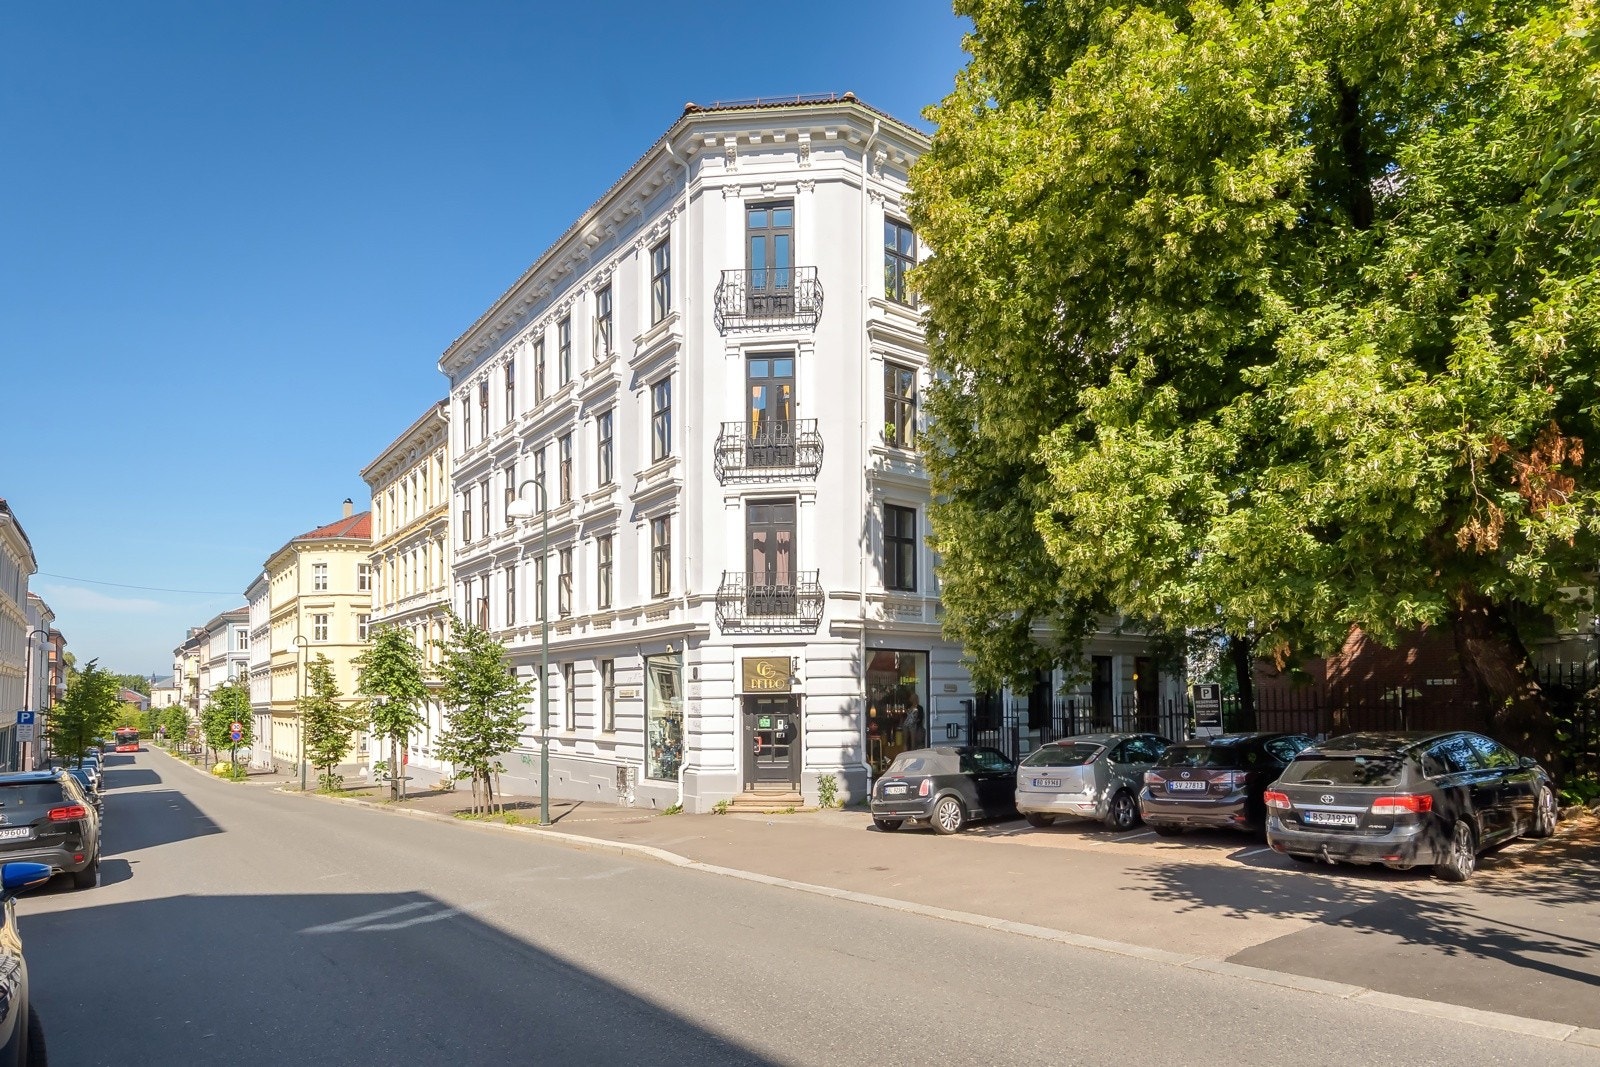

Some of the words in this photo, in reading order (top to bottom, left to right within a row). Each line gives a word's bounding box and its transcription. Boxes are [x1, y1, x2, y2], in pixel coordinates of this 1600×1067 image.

[751, 678, 785, 689] RETRO
[1203, 689, 1210, 698] P
[21, 712, 31, 723] P
[1175, 781, 1183, 789] SV
[1185, 781, 1204, 789] 27813
[1312, 812, 1323, 821] BS
[1326, 814, 1353, 824] 71920
